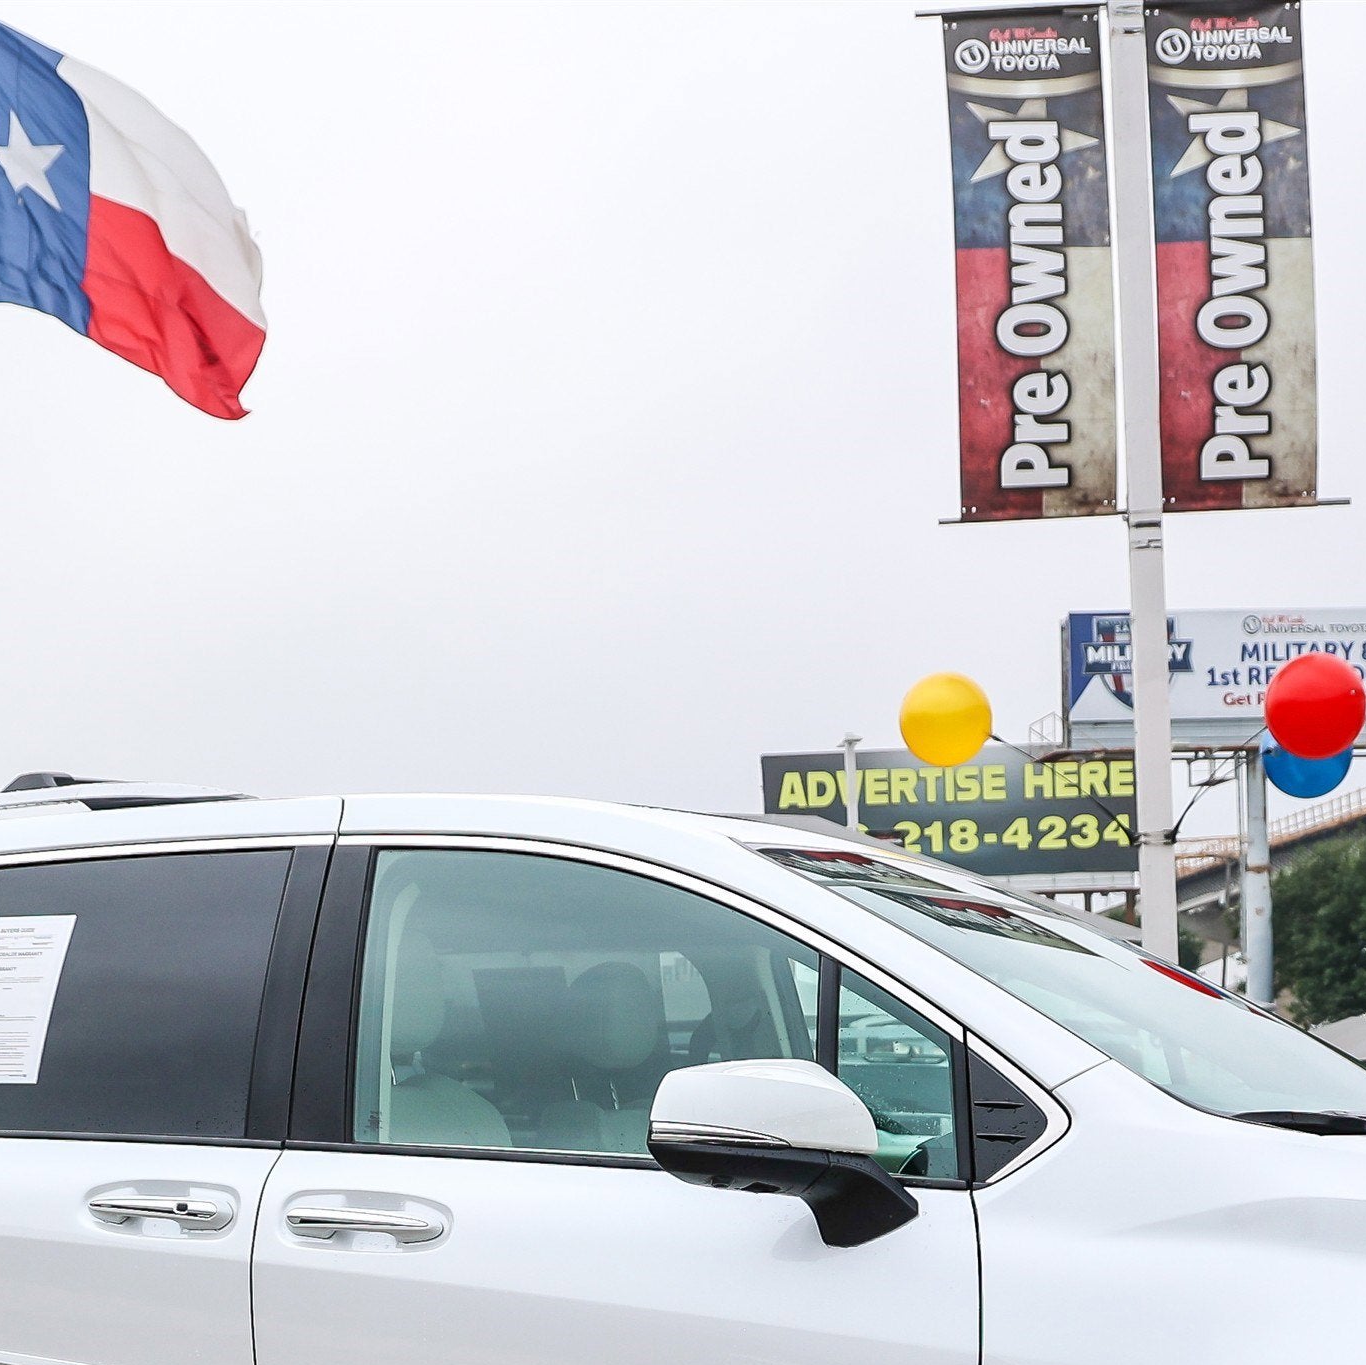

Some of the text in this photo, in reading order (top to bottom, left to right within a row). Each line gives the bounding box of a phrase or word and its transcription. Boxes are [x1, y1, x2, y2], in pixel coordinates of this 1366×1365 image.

[1191, 26, 1293, 44] UNIVERSAL
[990, 37, 1092, 55] UNIVERSAL
[1192, 43, 1262, 61] TOYOTA
[991, 54, 1060, 72] TOYOTA
[987, 120, 1069, 357] Owned
[1188, 111, 1270, 349] Owned
[1001, 371, 1070, 489] Pre
[1200, 364, 1270, 481] Pre
[1086, 643, 1187, 663] MILIY
[1207, 667, 1241, 686] 1st
[1223, 691, 1252, 706] Get
[778, 760, 1135, 810] ADVERTISE HERE
